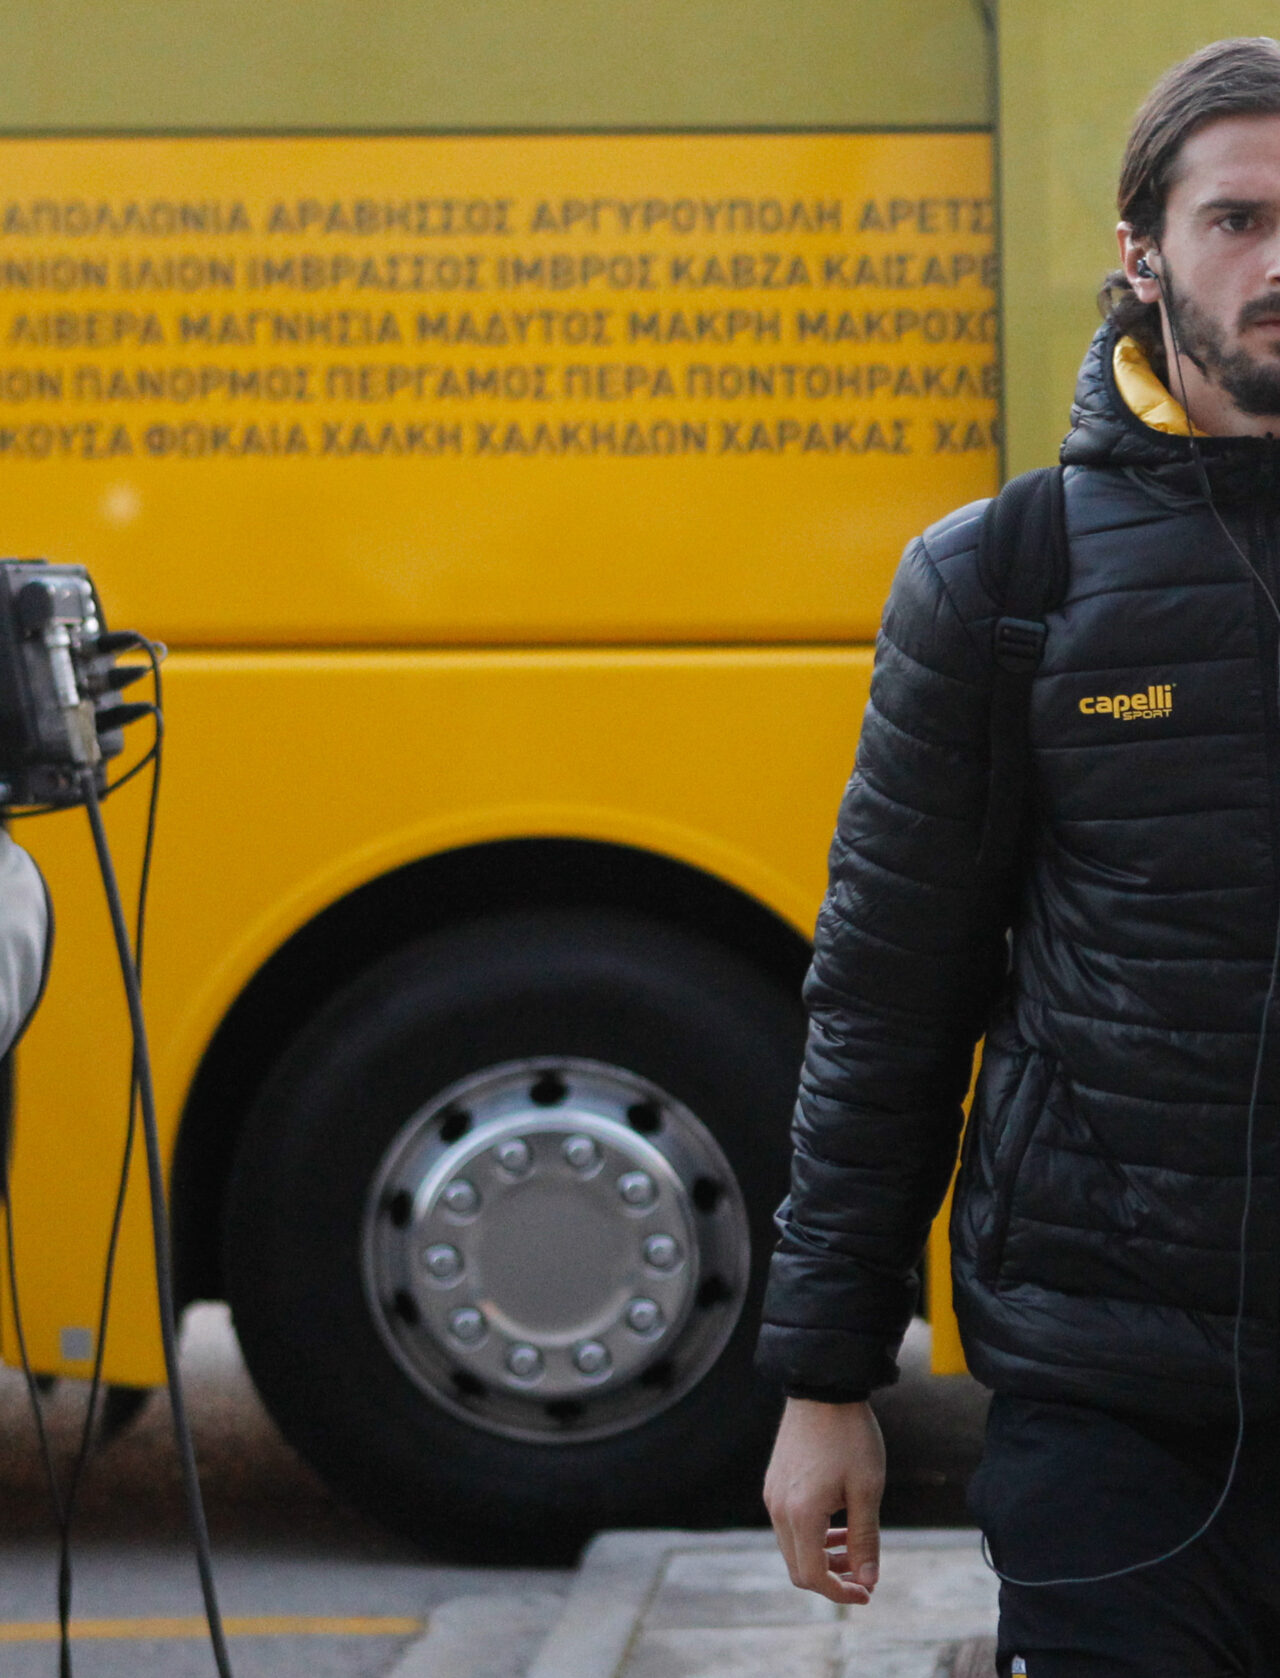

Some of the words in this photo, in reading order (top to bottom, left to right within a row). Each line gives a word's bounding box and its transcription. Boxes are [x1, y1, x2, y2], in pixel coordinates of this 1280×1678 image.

[264, 198, 515, 236] ΑΡΑΒΗΣΣΟΣ
[528, 198, 843, 234] ΑΡΓΥΡΟΥΠΟΛΗ
[116, 256, 236, 291] ΙΛΙΟΝ
[244, 254, 486, 292] ΙΜΒΡΑΣΣΟΣ
[493, 253, 659, 290] ΙΜΒΡΟΣ
[667, 254, 811, 290] ΚΑΒΖΑ
[9, 310, 165, 348] ΛΙΒΕΡΑ
[176, 311, 402, 346] ΜΑΓΝΗΣΙΑ
[413, 310, 613, 346] ΜΑΔΥΤΟΣ
[624, 310, 782, 344] ΜΑΚΡΗ
[69, 366, 314, 402] ΠΑΝΟΡΜΟΣ
[323, 364, 554, 400] ΠΕΡΓΑΜΟΣ
[562, 364, 676, 399] ΠΕΡΑ
[140, 422, 310, 458] ΦΩΚΑΙΑ
[319, 422, 464, 456] ΧΑΛΚΗ
[472, 421, 709, 456] ΧΑΛΚΗΔΩΝ
[717, 420, 912, 455] ΧΑΡΑΚΑΣ
[1079, 684, 1172, 719] capelli
[1122, 708, 1173, 720] SPORT
